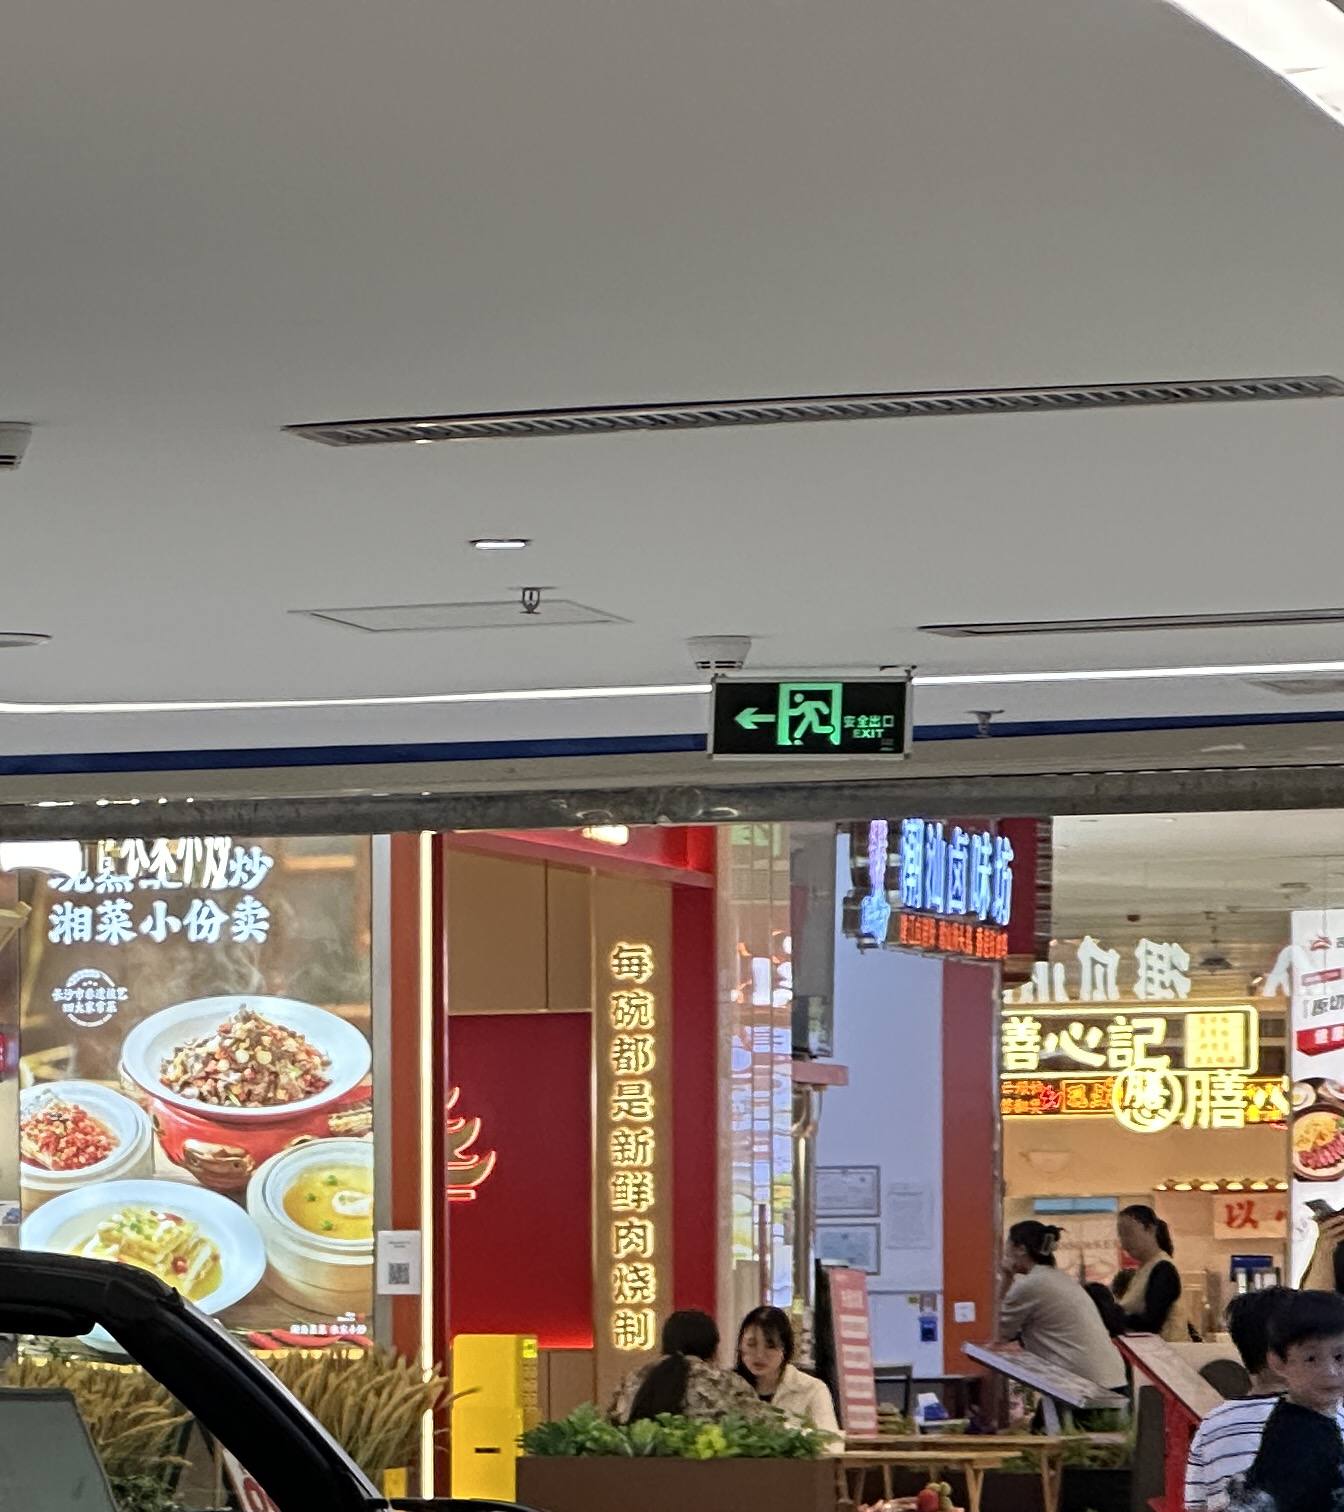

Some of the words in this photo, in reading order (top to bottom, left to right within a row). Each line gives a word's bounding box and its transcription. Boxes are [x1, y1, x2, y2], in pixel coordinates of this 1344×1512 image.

[843, 714, 895, 728] 安全出口
[853, 728, 885, 739] EXIT
[47, 894, 271, 946] 湘菜小份卖
[1002, 1015, 1171, 1070] 善心記
[611, 942, 655, 1351] 每碗都是新鲜肉烧制
